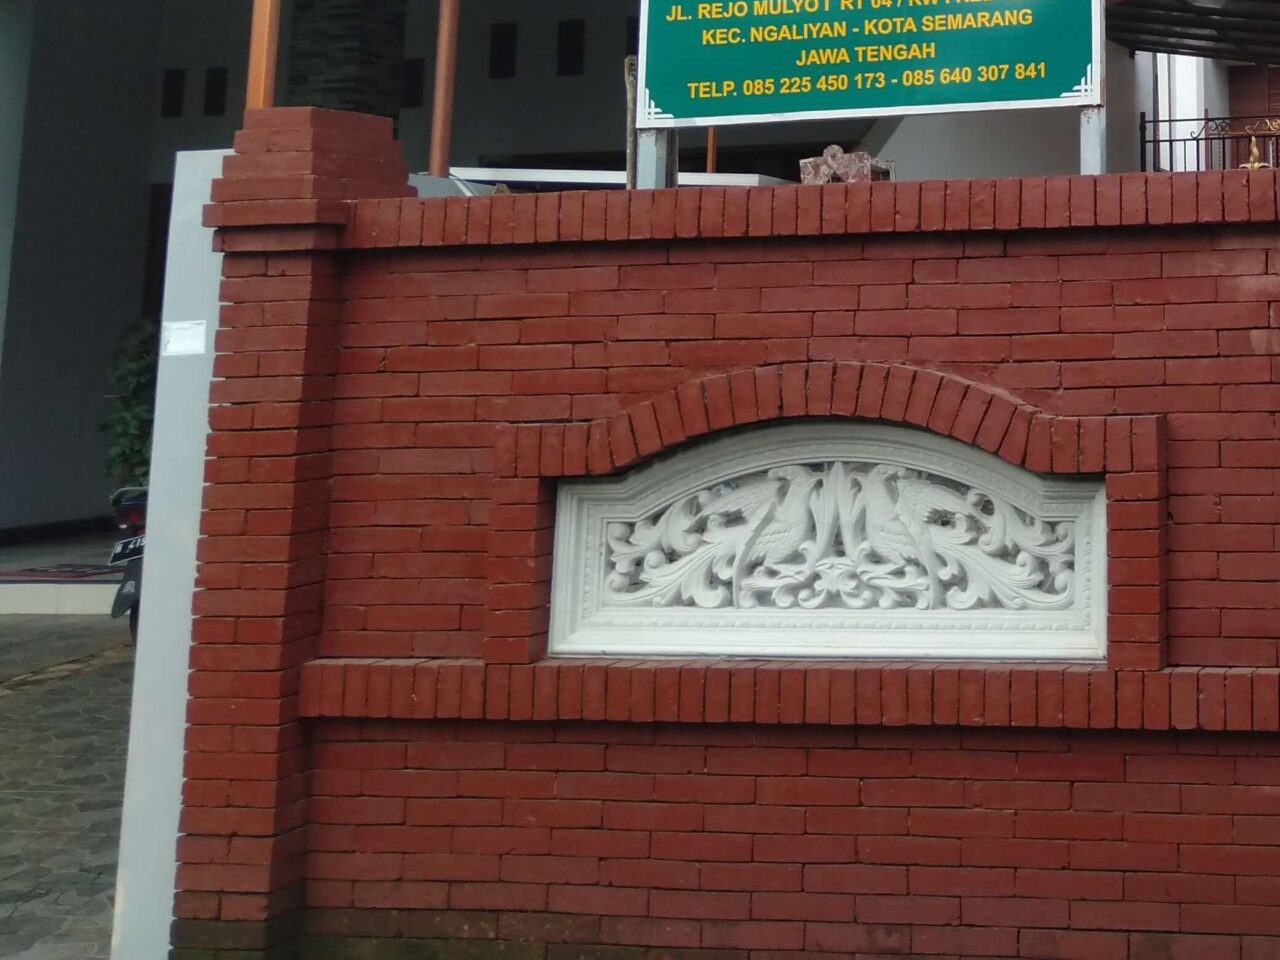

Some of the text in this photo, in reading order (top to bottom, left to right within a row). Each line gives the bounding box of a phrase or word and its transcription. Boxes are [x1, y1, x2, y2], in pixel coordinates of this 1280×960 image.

[666, 5, 692, 21] JL.
[697, 0, 749, 19] REJO
[702, 27, 746, 45] KEC.
[750, 21, 847, 42] NGALIYAN
[864, 17, 917, 35] KOTA
[921, 8, 1033, 32] SEMARANG
[796, 42, 936, 66] JAWA TENGAH
[687, 80, 738, 99] TELP.
[742, 78, 775, 96] 085
[779, 75, 812, 94] 225
[815, 74, 848, 92] 450
[854, 71, 886, 89] 173
[902, 69, 935, 87] 085
[939, 66, 972, 84] 640
[977, 64, 1009, 82] 307
[1014, 62, 1045, 80] 841
